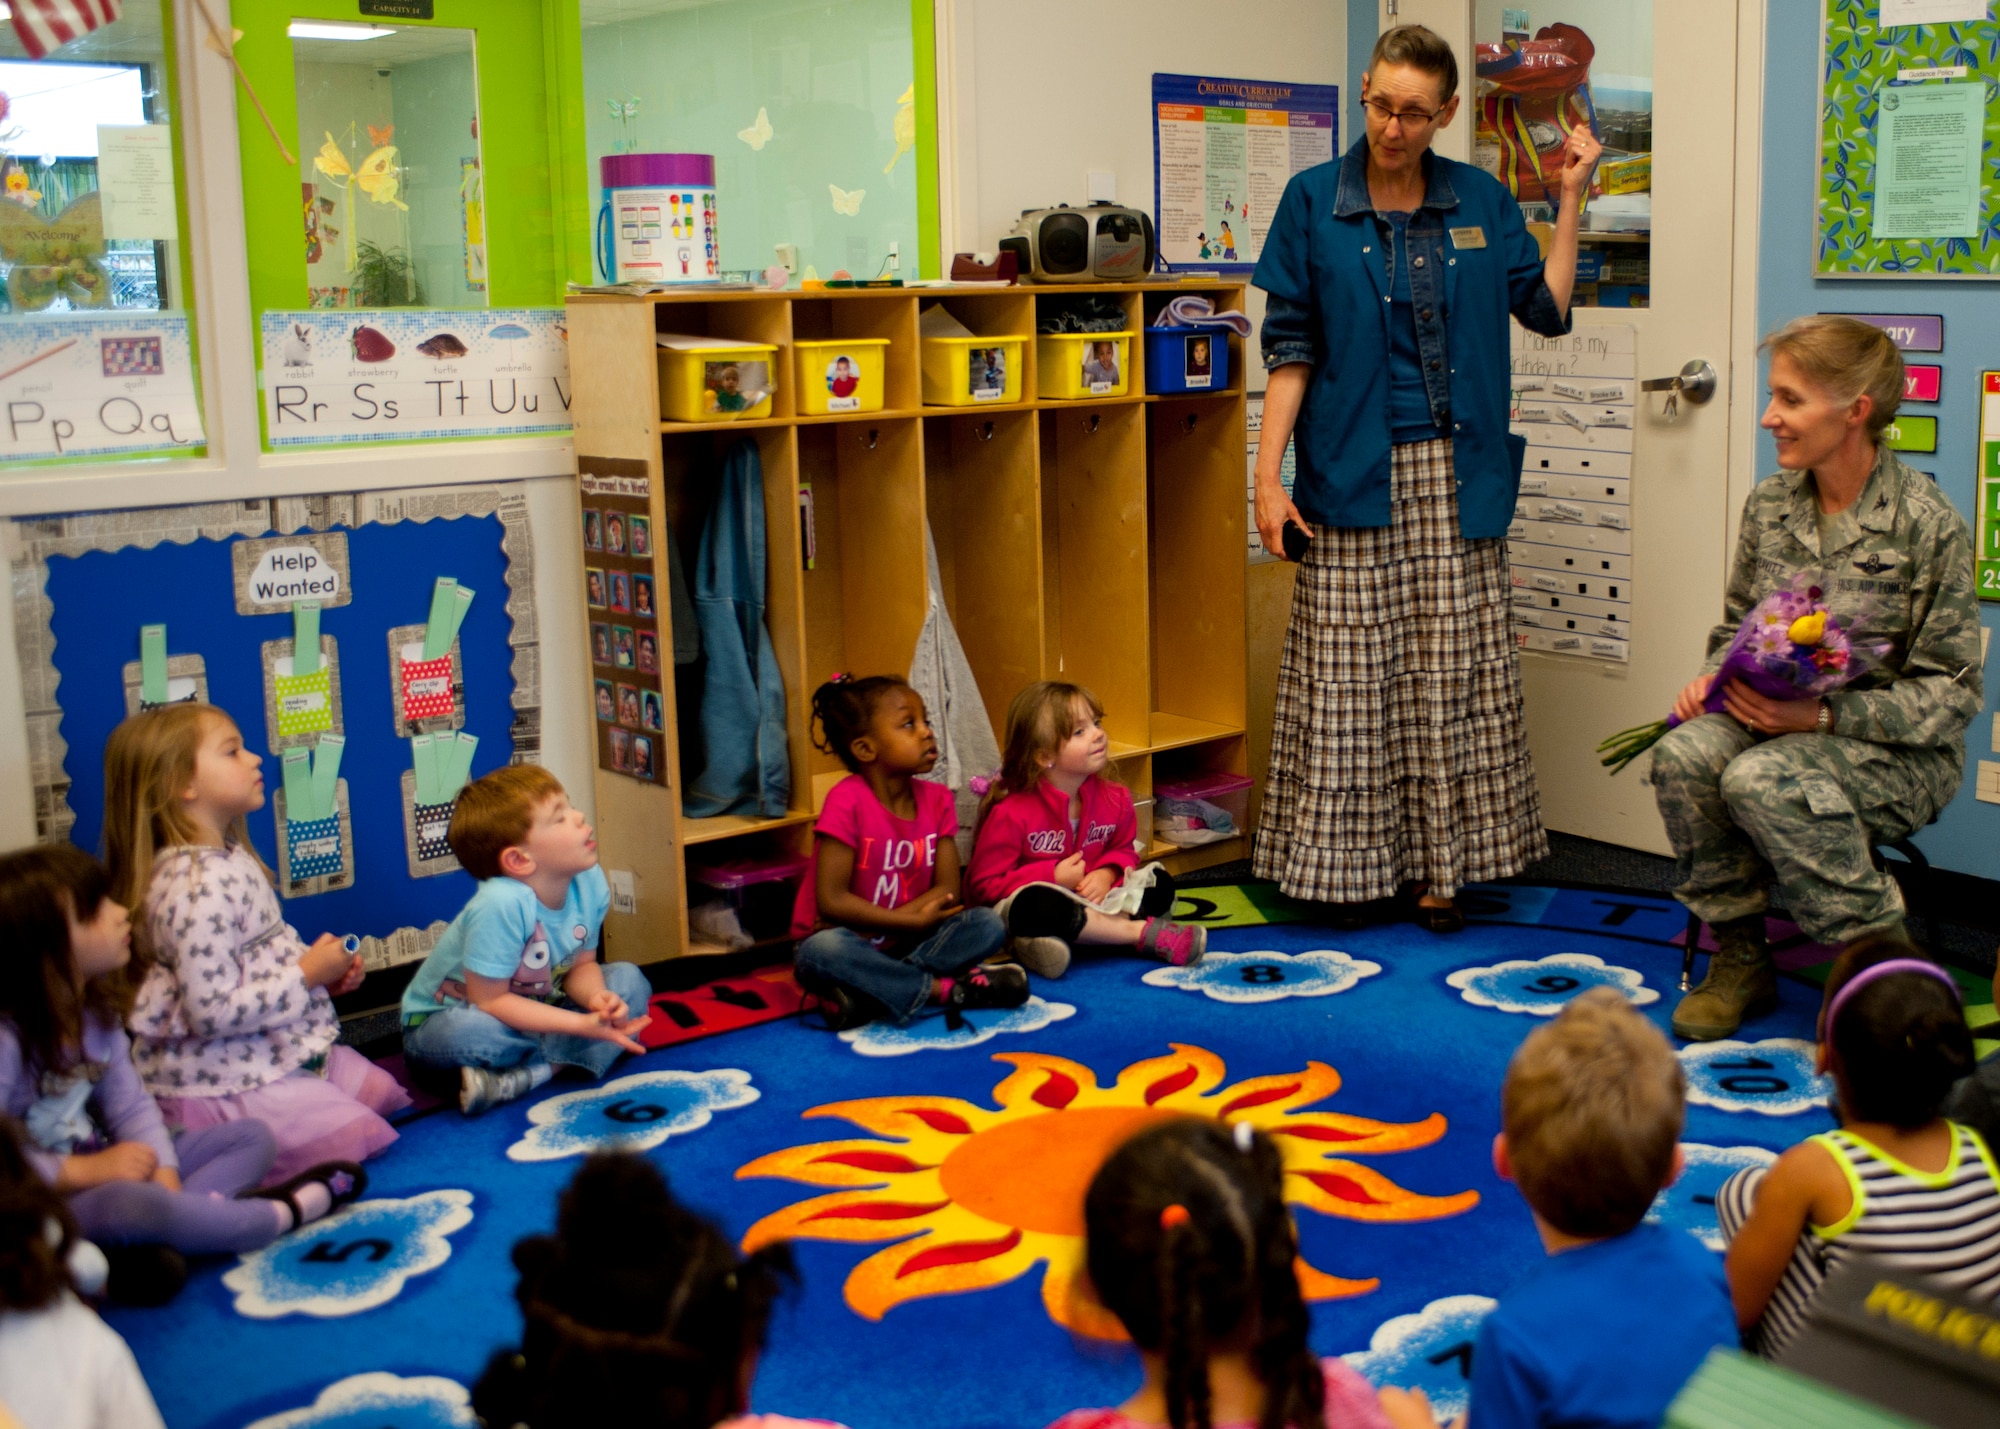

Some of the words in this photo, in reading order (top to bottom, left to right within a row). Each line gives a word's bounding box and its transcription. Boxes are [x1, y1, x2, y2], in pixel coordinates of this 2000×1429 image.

[373, 4, 410, 14] CAPACITY
[1937, 69, 1954, 77] Policy
[1218, 99, 1234, 107] GOALS
[1246, 101, 1273, 109] OBJECTIVES
[25, 229, 80, 242] Welcome
[1883, 325, 1915, 344] ary
[1588, 337, 1608, 361] my
[285, 370, 314, 379] rabbit
[348, 367, 399, 379] strawberry
[433, 365, 458, 375] turtle
[495, 363, 532, 373] umbrella
[1511, 353, 1551, 381] irthday
[21, 383, 53, 396] pencil
[124, 378, 147, 392] quilt
[618, 479, 630, 493] the
[1555, 504, 1579, 517] Nicholas
[271, 552, 317, 573] Help
[256, 575, 335, 599] Wanted
[1858, 579, 1874, 593] AIR
[1878, 580, 1909, 594] FORCE
[285, 698, 308, 706] reading
[1028, 830, 1065, 853] Old
[857, 837, 876, 871] I
[882, 833, 938, 871] LOVE
[872, 872, 920, 910] MY
[1240, 964, 1286, 985] 8
